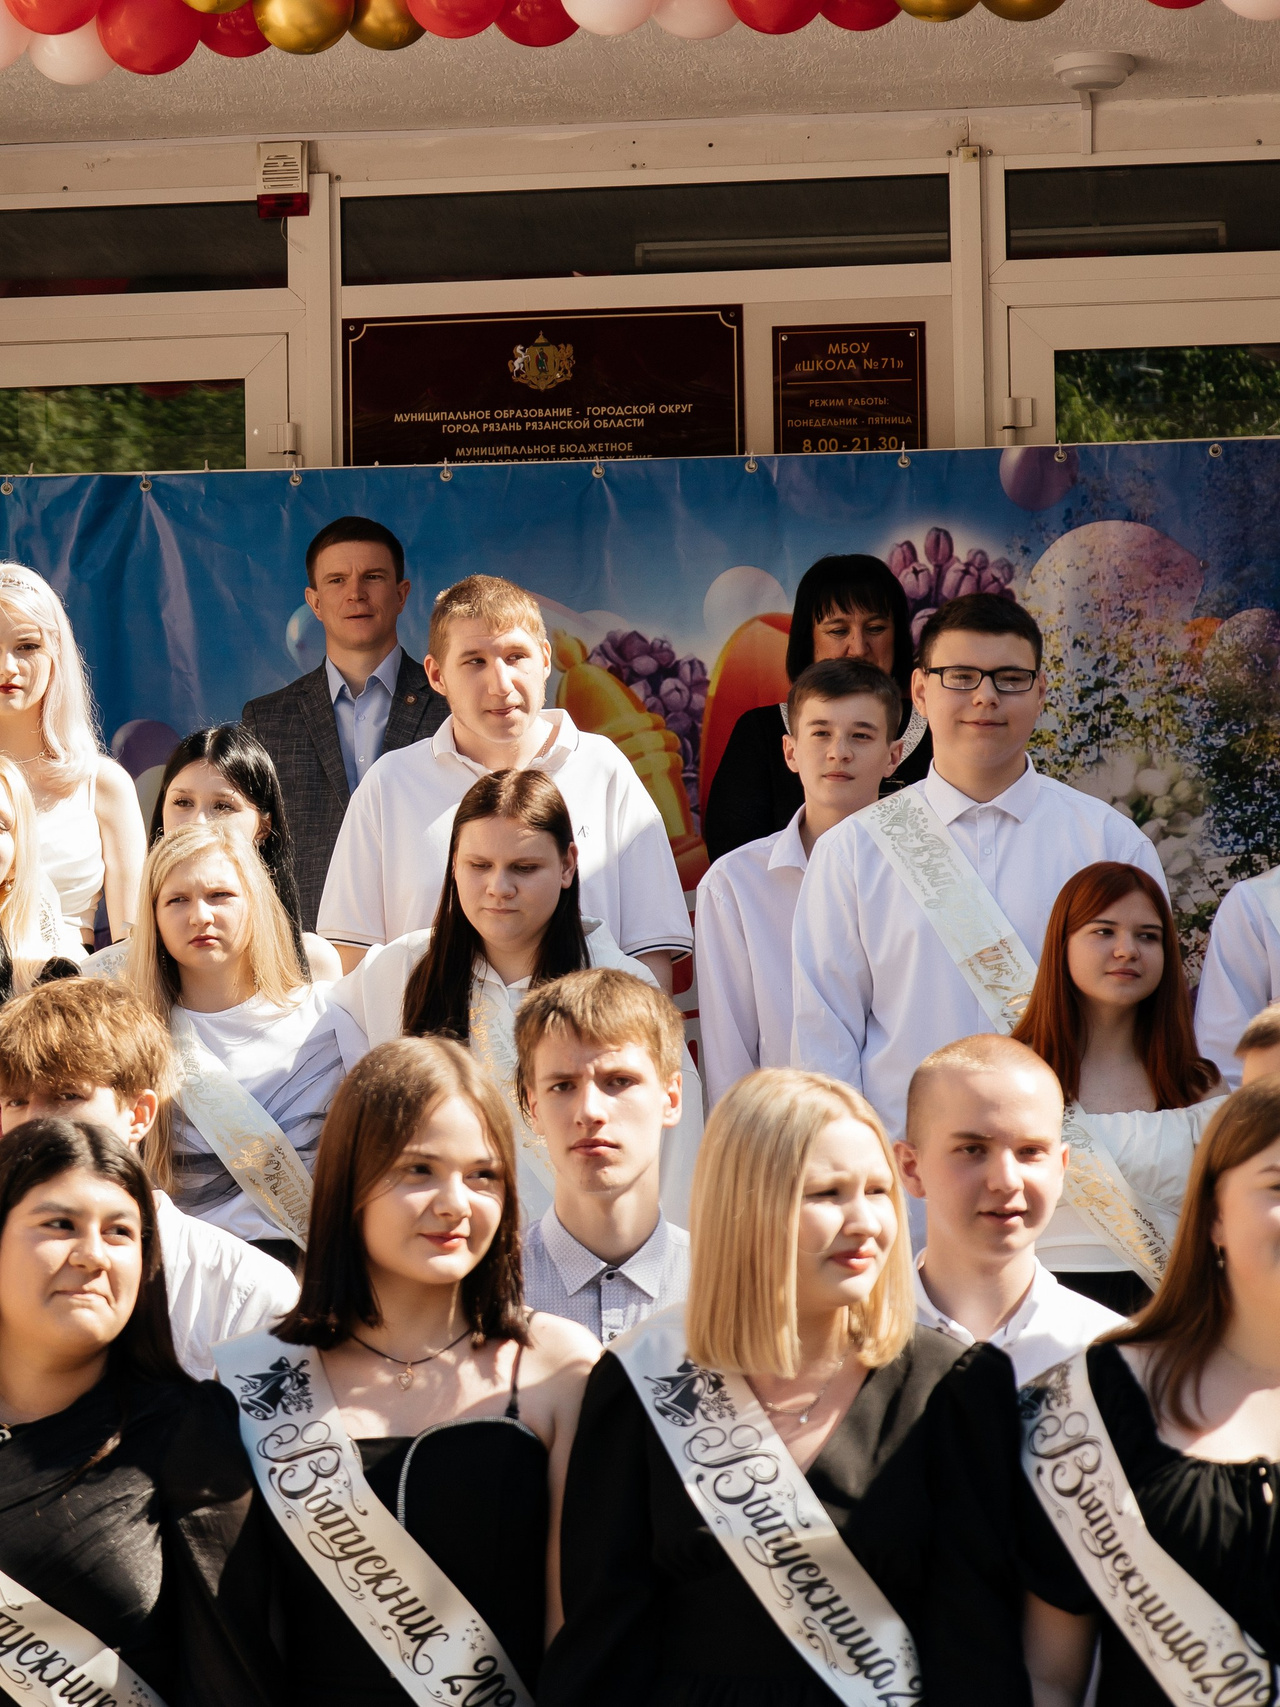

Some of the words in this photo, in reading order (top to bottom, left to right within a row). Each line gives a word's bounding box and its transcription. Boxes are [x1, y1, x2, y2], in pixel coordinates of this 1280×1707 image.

[828, 342, 870, 354] МБОУ
[795, 359, 856, 371] «ШКОЛА
[809, 398, 844, 407] РЕЖИМ
[848, 397, 889, 406] РАБОТЫ:
[394, 410, 491, 423] МУНИЦИПАЛЬНОЕ
[494, 408, 572, 420] ОБРАЗОВАНИЕ
[586, 403, 655, 416] ГОРОДСКОЙ
[659, 404, 693, 415] ОКРУГ
[442, 423, 479, 434] ГОРОД
[483, 421, 522, 432] РЯЗАНЬ
[525, 418, 590, 430] РЯЗАНСКОЙ
[593, 418, 645, 429] ОБЛАСТИ
[787, 418, 858, 427] ПОНЕДЕЛЬНИК
[867, 416, 913, 425] ПЯТНИЦА
[455, 444, 556, 457] МУНИЦИПАЛЬНОЕ
[559, 442, 633, 453] БЮДЖЕТНОЕ
[802, 438, 838, 453] 8.00
[851, 436, 898, 452] 21.30
[257, 1420, 449, 1676] Выпускник
[1029, 1411, 1208, 1673] Выпускница
[683, 1424, 898, 1690] Выпускница
